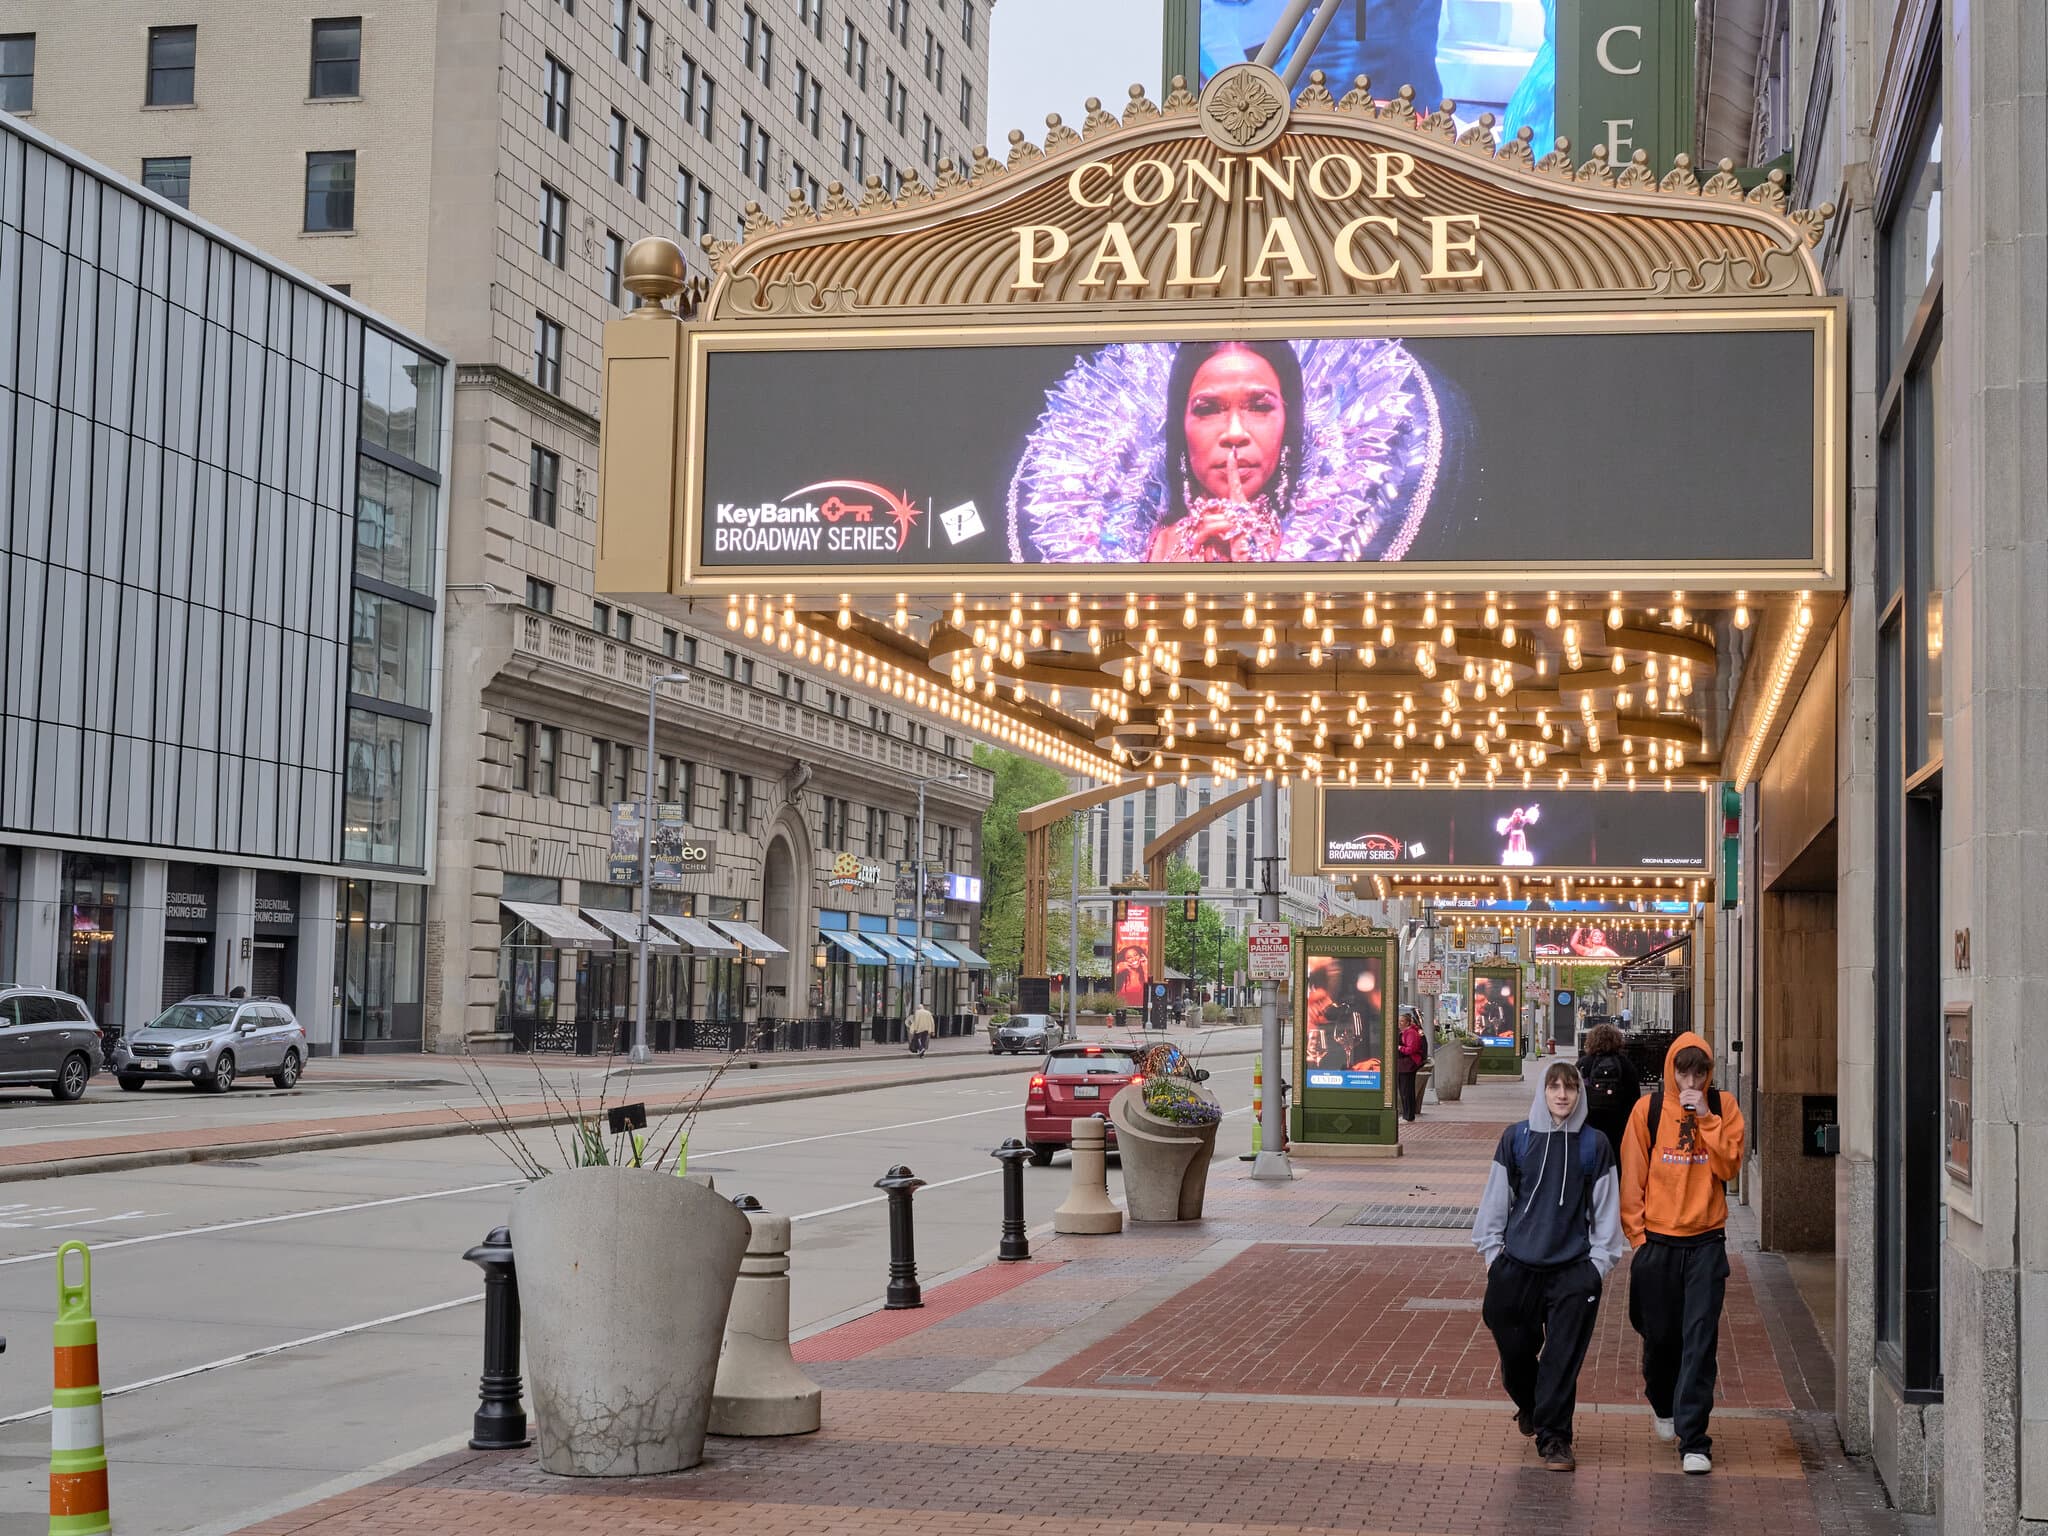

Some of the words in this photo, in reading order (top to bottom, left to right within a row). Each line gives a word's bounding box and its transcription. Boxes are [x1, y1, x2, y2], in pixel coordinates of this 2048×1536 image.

[1068, 151, 1426, 208] CONNOR
[1010, 213, 1485, 289] PALACE
[716, 502, 820, 527] KeyBank
[715, 526, 823, 552] BROADWAY
[827, 526, 897, 551] SERIES
[1329, 841, 1367, 850] KeyBank
[1328, 850, 1368, 860] BROADWAY
[1369, 850, 1395, 860] SERIES
[167, 892, 206, 906] ESIDENTIAL
[255, 898, 290, 911] ESIDENTIAL
[166, 906, 191, 918] ARKING
[191, 907, 207, 919] EXIT
[273, 912, 294, 923] ENTRY
[1256, 937, 1282, 945] NO
[1250, 944, 1288, 952] PARKING
[1306, 944, 1352, 952] PLAYHOUSE
[1352, 944, 1385, 953] SQUARE
